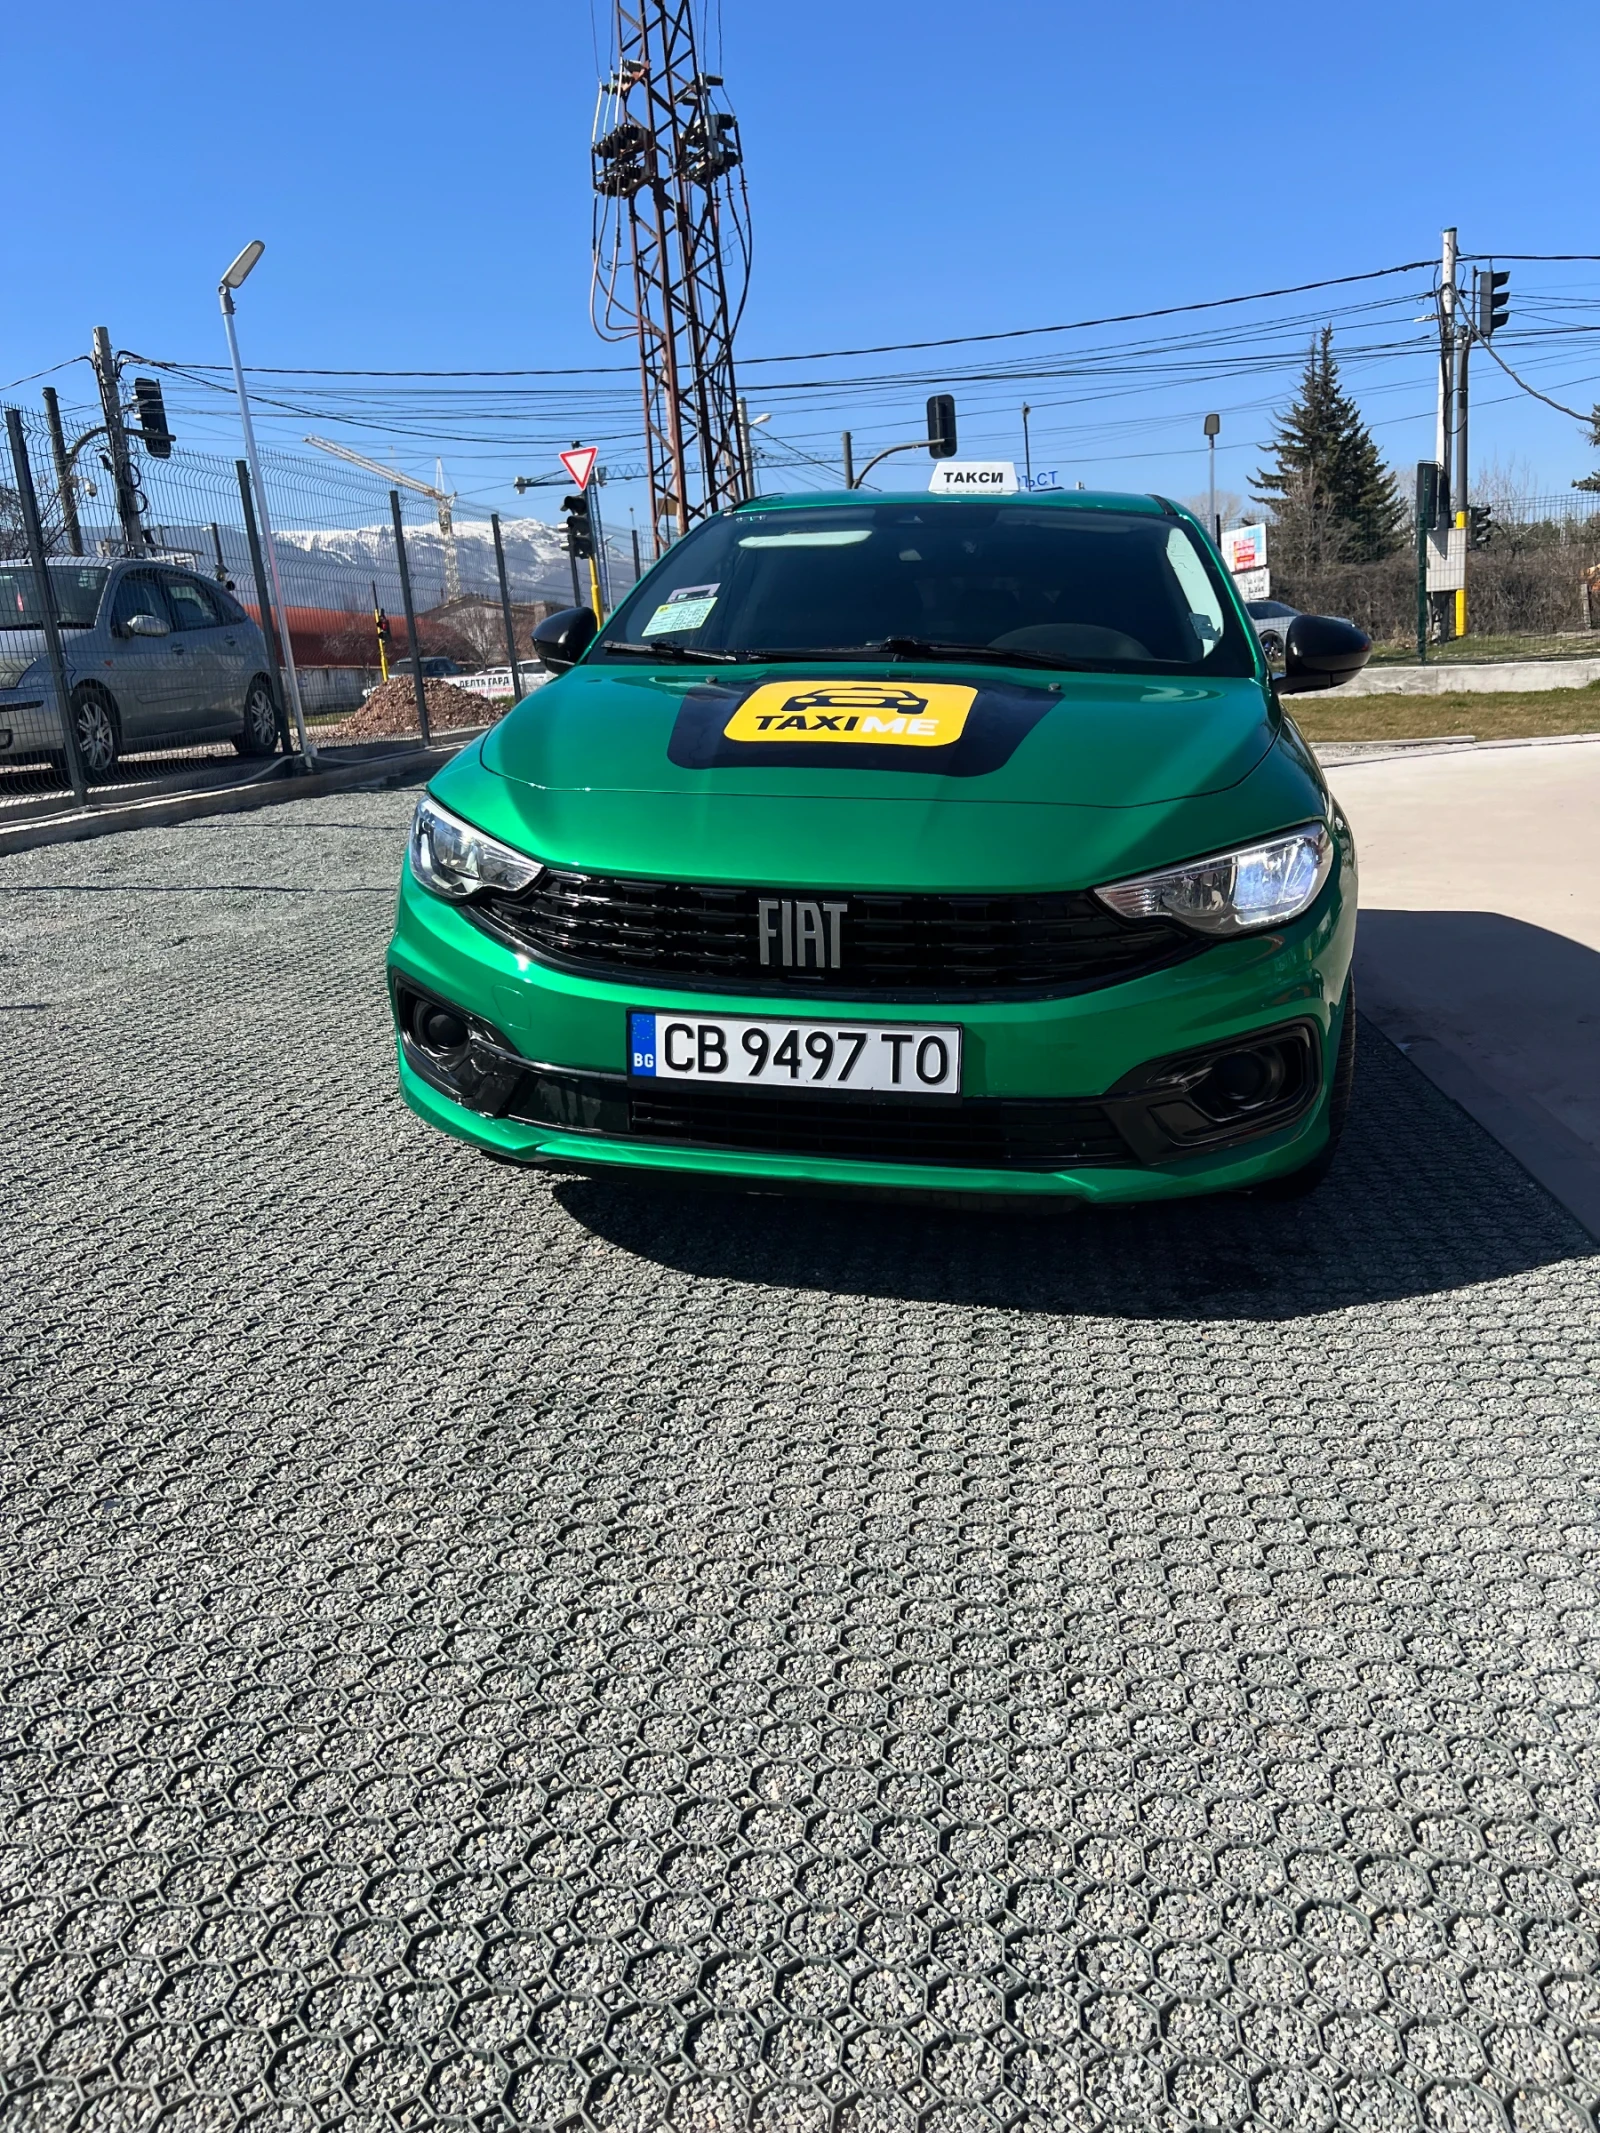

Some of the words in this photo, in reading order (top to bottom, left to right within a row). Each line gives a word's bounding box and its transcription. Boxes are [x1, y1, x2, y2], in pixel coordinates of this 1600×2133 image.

[944, 472, 1004, 483] ТАКСИ
[459, 678, 486, 688] ДЕЛТА
[488, 676, 510, 686] ГАРД
[758, 899, 848, 969] FIAT
[633, 1052, 654, 1067] BG
[664, 1023, 729, 1074] CB
[741, 1027, 868, 1082] 9497
